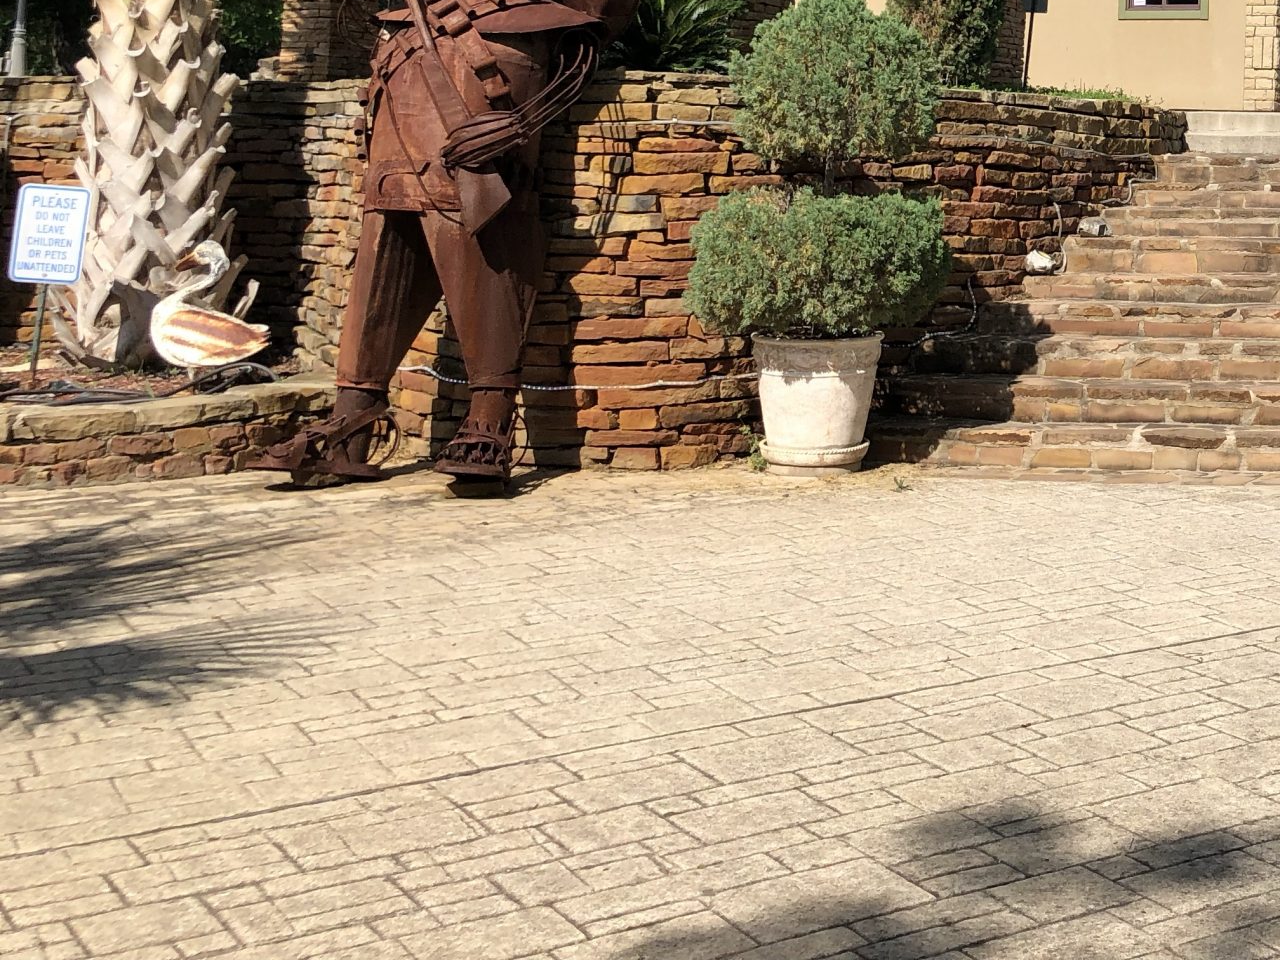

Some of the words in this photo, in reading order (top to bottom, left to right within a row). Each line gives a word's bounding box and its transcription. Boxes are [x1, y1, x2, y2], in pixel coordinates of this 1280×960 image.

[32, 195, 78, 209] PLEASE
[35, 211, 48, 221] DO
[52, 212, 70, 222] NOT
[37, 224, 65, 235] LEAVE
[27, 236, 72, 247] CHILDREN
[28, 249, 41, 259] OR
[45, 250, 67, 260] PETS
[17, 261, 75, 273] UNATTENDED
